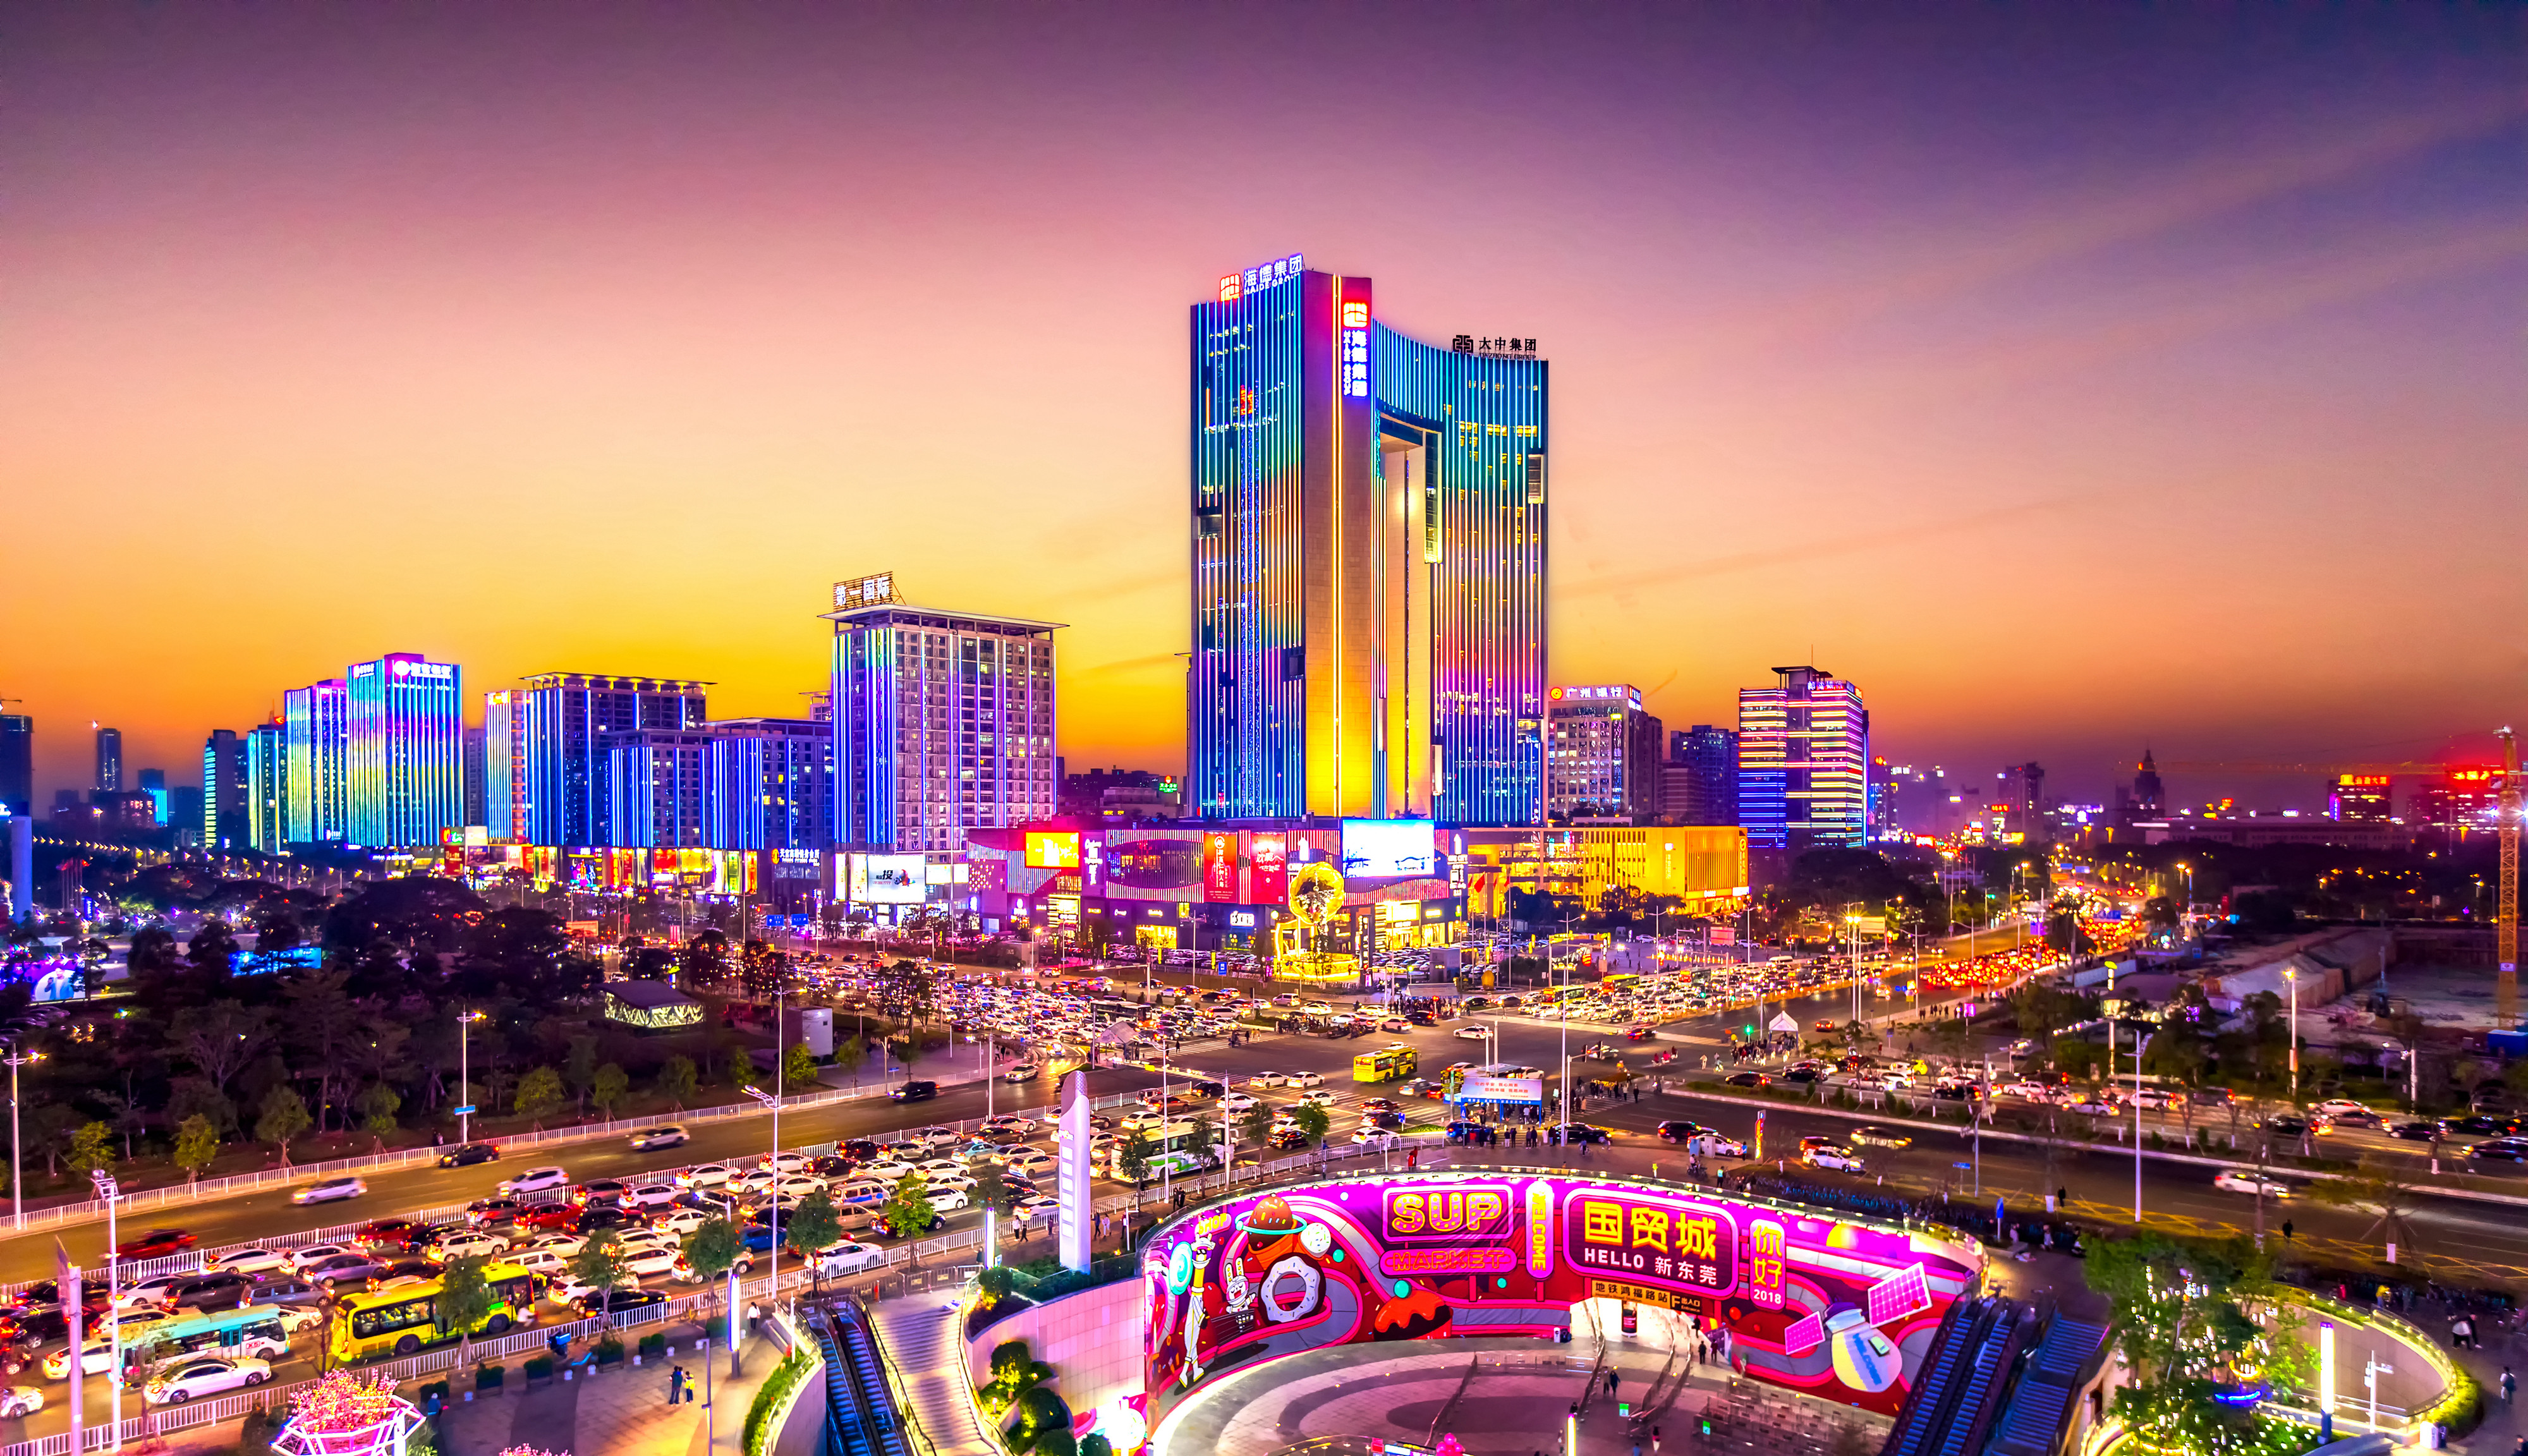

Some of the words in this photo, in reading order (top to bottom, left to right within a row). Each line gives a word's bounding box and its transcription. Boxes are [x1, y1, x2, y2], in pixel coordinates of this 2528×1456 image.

[1243, 253, 1303, 288] 海德集团
[1244, 282, 1270, 295] HAIDE
[1272, 272, 1301, 287] GRO
[1479, 336, 1536, 351] 大中集团
[836, 576, 890, 606] 第一国际
[1566, 686, 1622, 698] 广州银行
[1198, 1213, 1227, 1235] SHOP
[1392, 1192, 1502, 1233] SUP
[1532, 1192, 1547, 1271] WELCOME
[1584, 1201, 1717, 1261] 国贸城
[1393, 1250, 1505, 1271] MARKET
[1584, 1247, 1644, 1268] HELLO
[1655, 1256, 1717, 1285] 新东莞
[1753, 1225, 1783, 1290] 你好
[1596, 1282, 1668, 1303] 地铁鸿福路站
[1671, 1295, 1680, 1307] F
[1753, 1289, 1782, 1304] 2018
